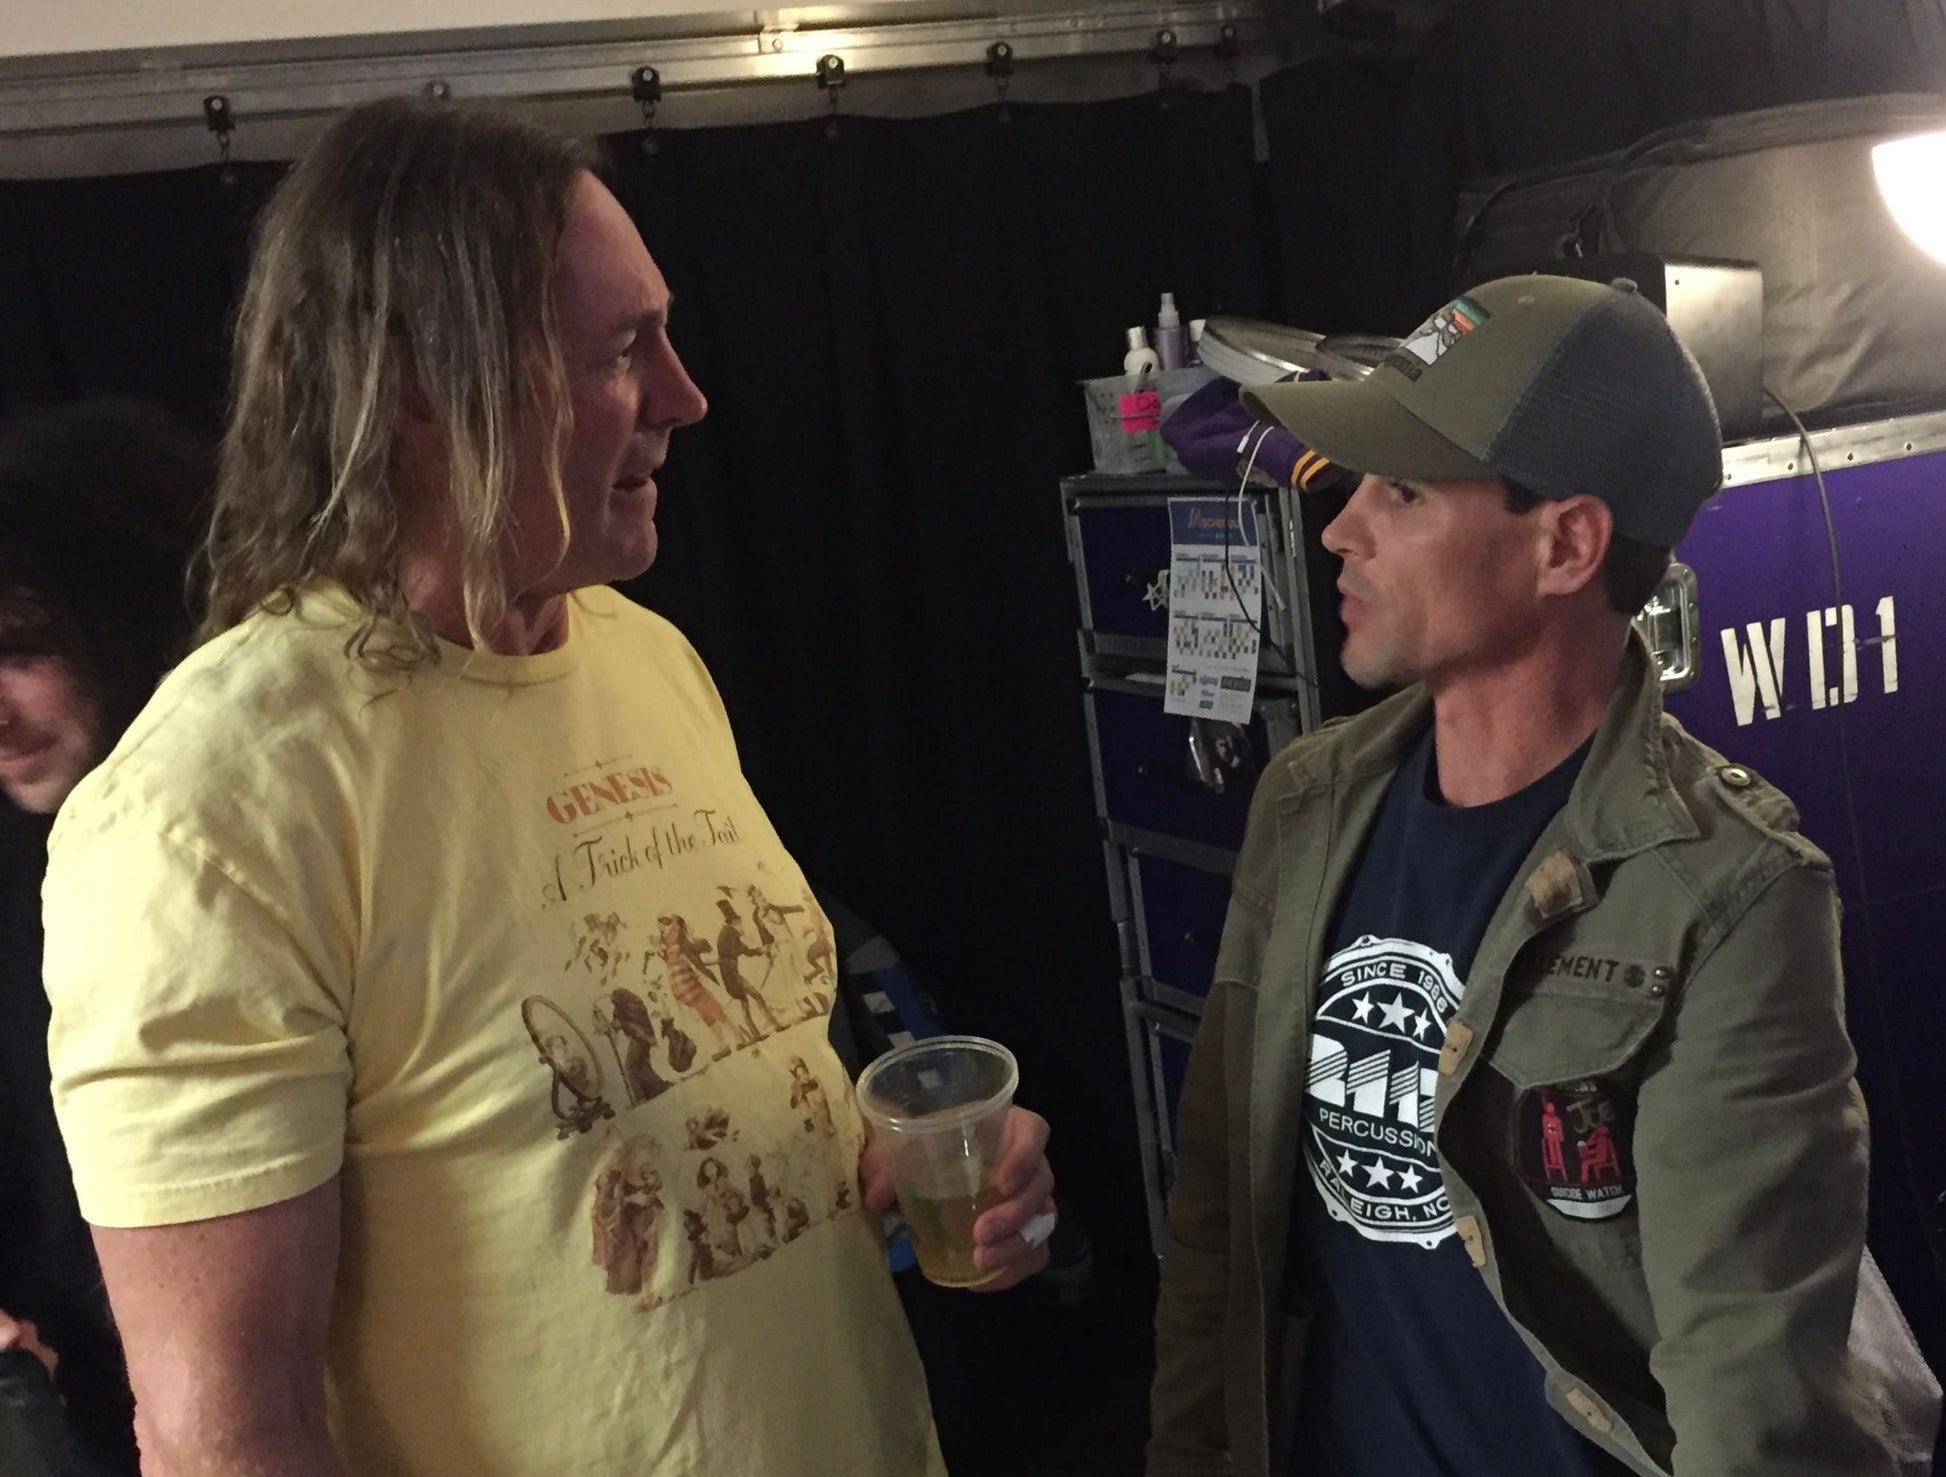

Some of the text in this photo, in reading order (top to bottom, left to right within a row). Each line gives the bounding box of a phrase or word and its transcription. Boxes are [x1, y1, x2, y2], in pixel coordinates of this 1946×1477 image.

[546, 767, 673, 824] GENESIS
[573, 836, 640, 888] Trick
[645, 827, 664, 870] of
[665, 822, 695, 856] the
[693, 809, 740, 846] Tail
[1341, 961, 1449, 1014] SINCE 1986
[1535, 953, 1621, 984] EMENT
[1319, 1107, 1437, 1157] PERCUSSION
[1318, 1159, 1451, 1222] RALEIGH, NC
[1585, 1184, 1623, 1200] WATCH
